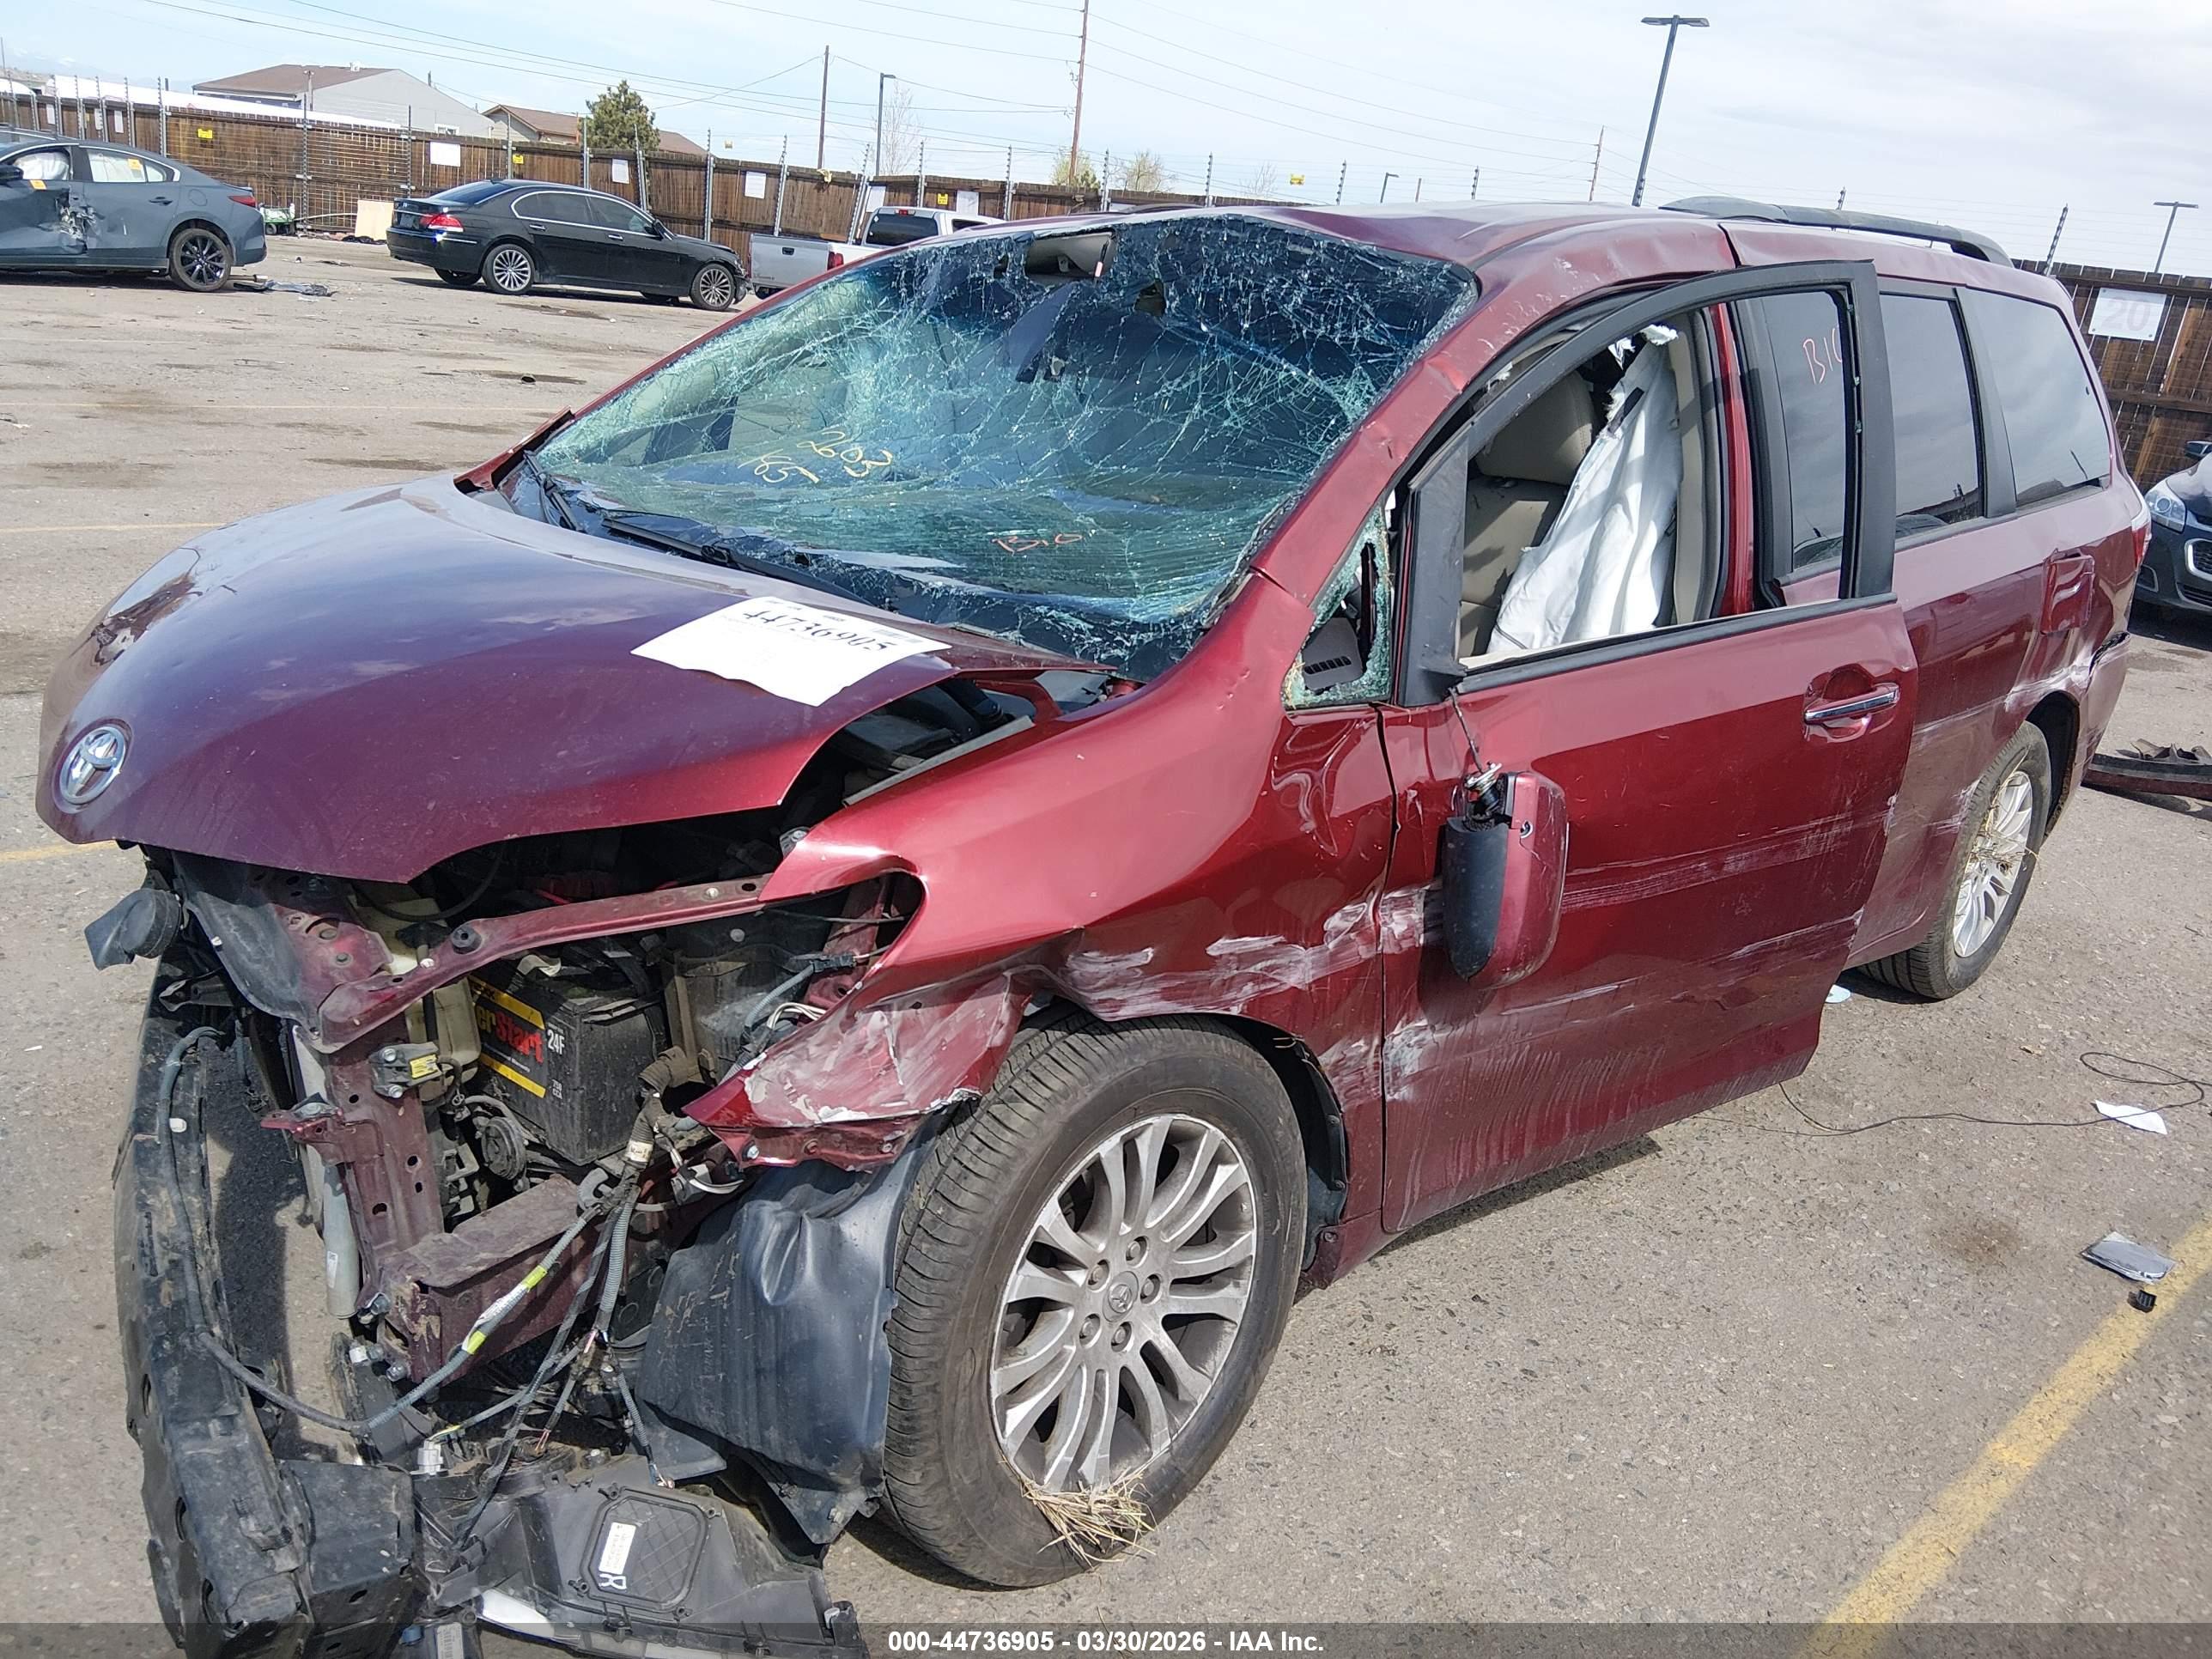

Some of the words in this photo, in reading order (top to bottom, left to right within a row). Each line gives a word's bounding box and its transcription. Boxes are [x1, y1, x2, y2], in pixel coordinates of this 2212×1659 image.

[2101, 297, 2150, 331] 20
[797, 430, 893, 477] 2603
[743, 610, 898, 651] 44736905
[475, 1005, 544, 1065] erStart
[546, 1029, 566, 1055] 24F
